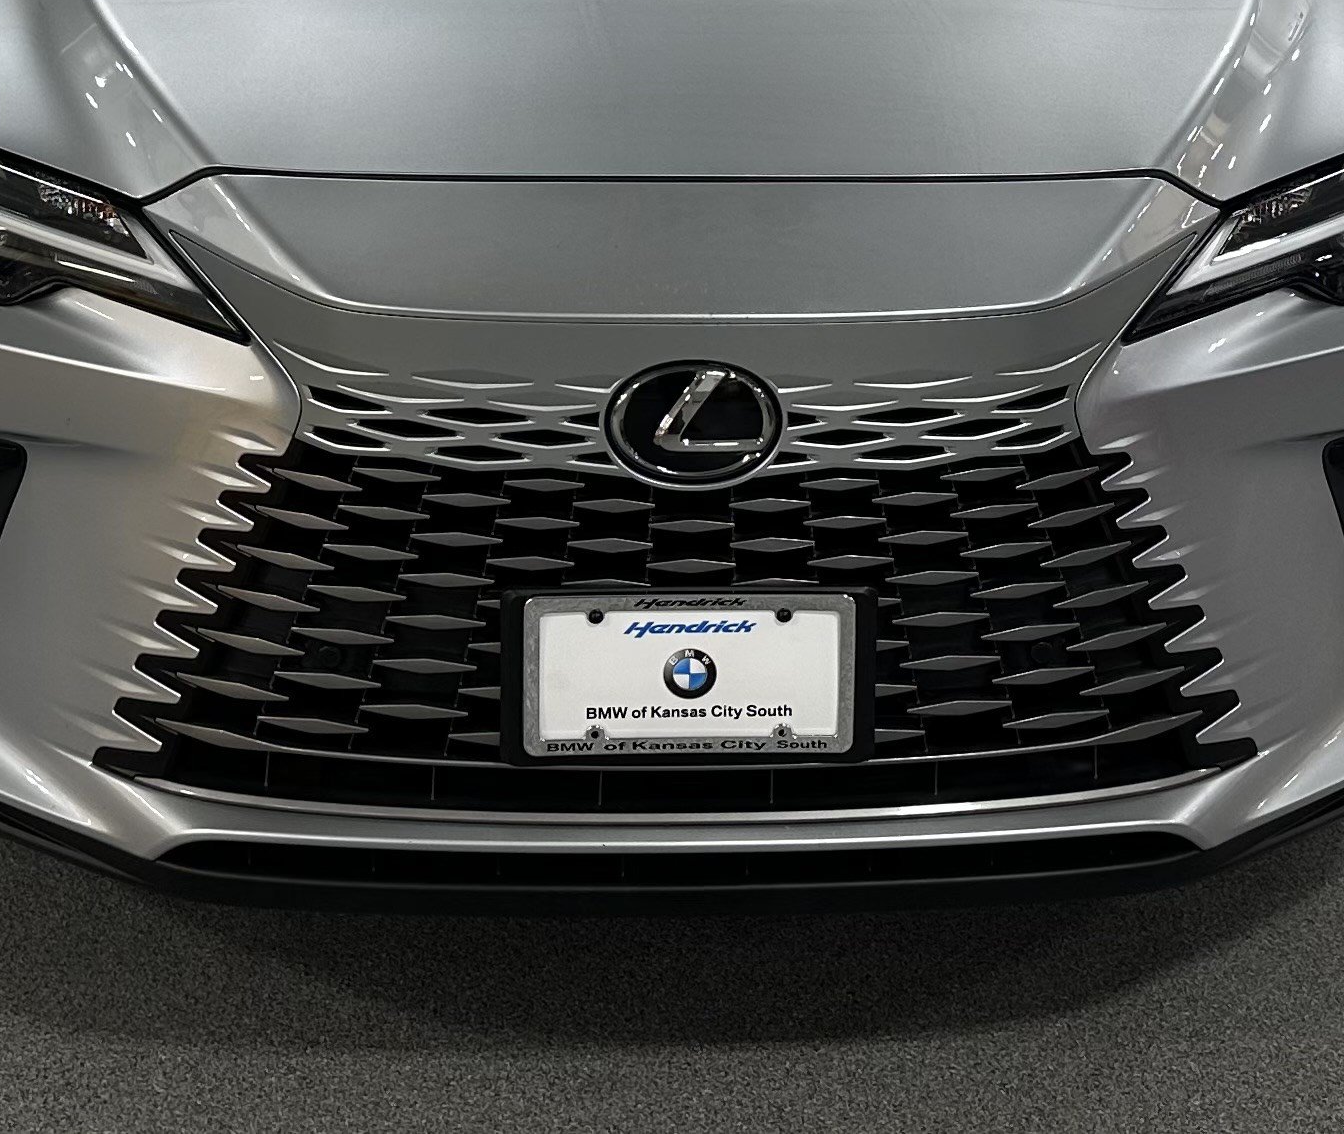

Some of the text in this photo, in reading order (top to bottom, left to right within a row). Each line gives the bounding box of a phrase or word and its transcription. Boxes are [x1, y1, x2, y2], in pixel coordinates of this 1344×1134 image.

[633, 597, 748, 610] Hendrick
[623, 620, 757, 639] Hendrick
[668, 649, 713, 666] BMW
[586, 704, 793, 720] BMW of Kansas City South
[546, 739, 828, 753] BMW of Kansas City South
